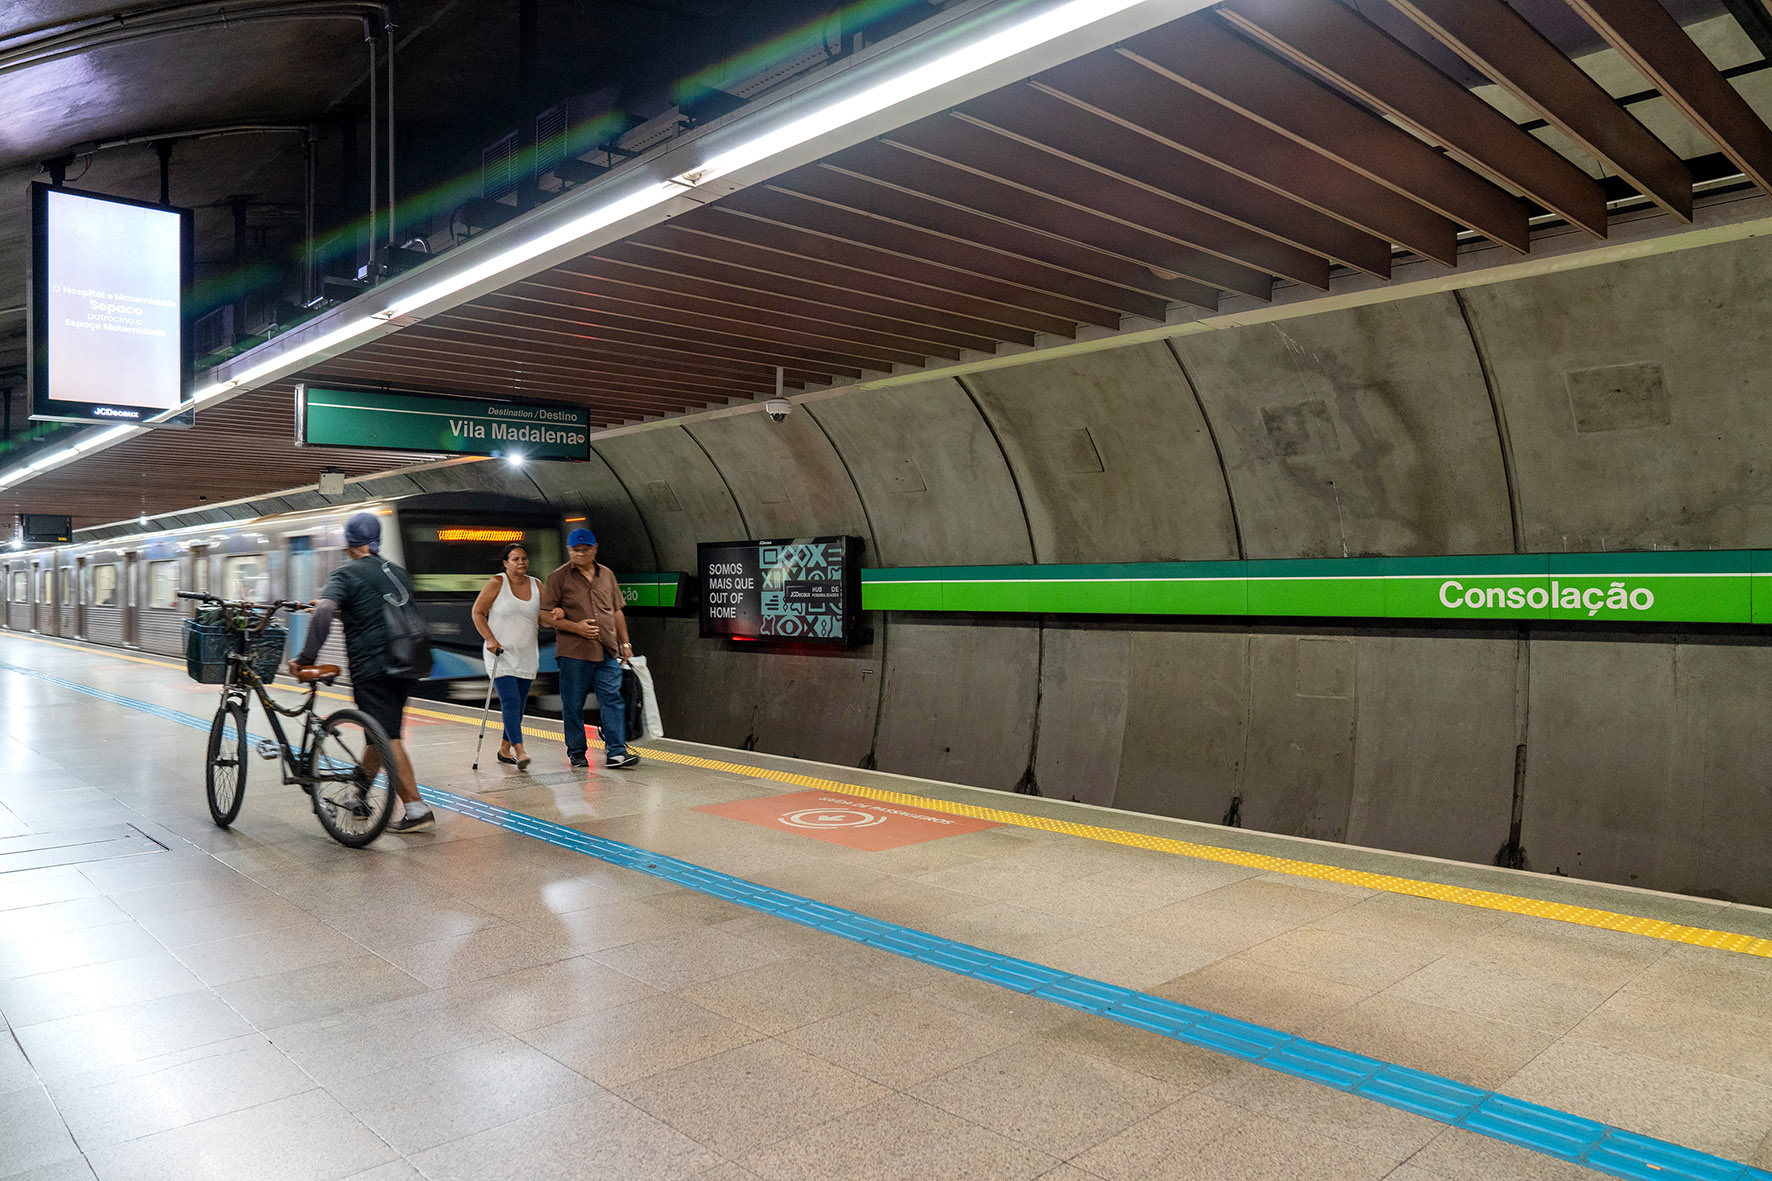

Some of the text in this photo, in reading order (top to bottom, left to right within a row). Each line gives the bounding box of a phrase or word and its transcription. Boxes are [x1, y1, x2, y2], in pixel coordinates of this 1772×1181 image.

[52, 284, 61, 293] O
[63, 286, 105, 299] Hospital
[115, 293, 177, 308] Maternidade
[89, 300, 143, 316] Sepaco
[87, 313, 134, 325] patrocina
[65, 319, 167, 337] Espaço Maternidade
[93, 407, 139, 418] JCDecaux
[488, 407, 533, 418] Destination
[539, 409, 578, 421] Destino
[449, 419, 577, 445] Vila Madalena
[709, 563, 743, 575] SOMOS
[709, 577, 754, 589] MAIS QUE
[709, 592, 744, 604] OUT OF
[1439, 580, 1655, 617] Consolação
[709, 607, 736, 619] HOME
